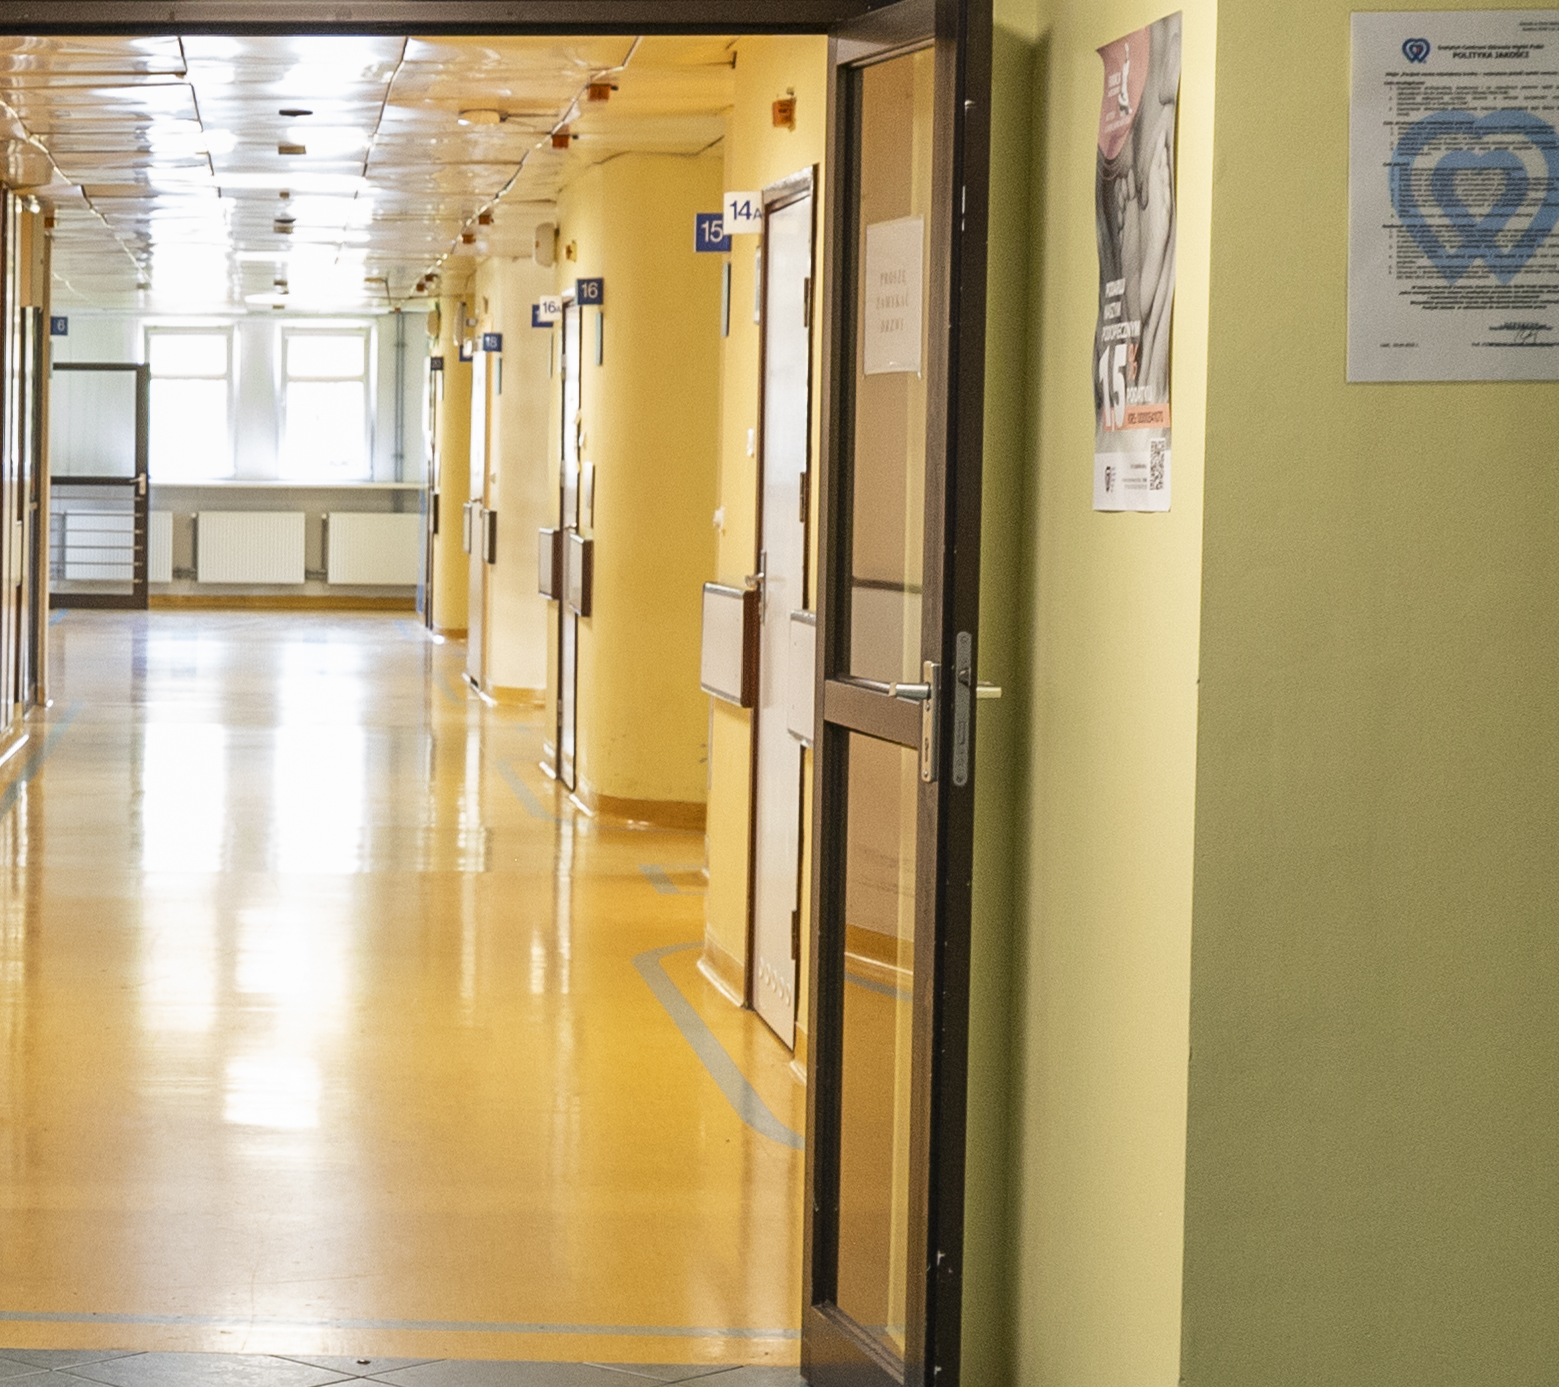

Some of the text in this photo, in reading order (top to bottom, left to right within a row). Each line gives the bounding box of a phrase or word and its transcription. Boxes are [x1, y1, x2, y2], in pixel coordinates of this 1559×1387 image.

[701, 219, 723, 243] 15
[581, 282, 598, 298] 16
[485, 335, 498, 348] 18
